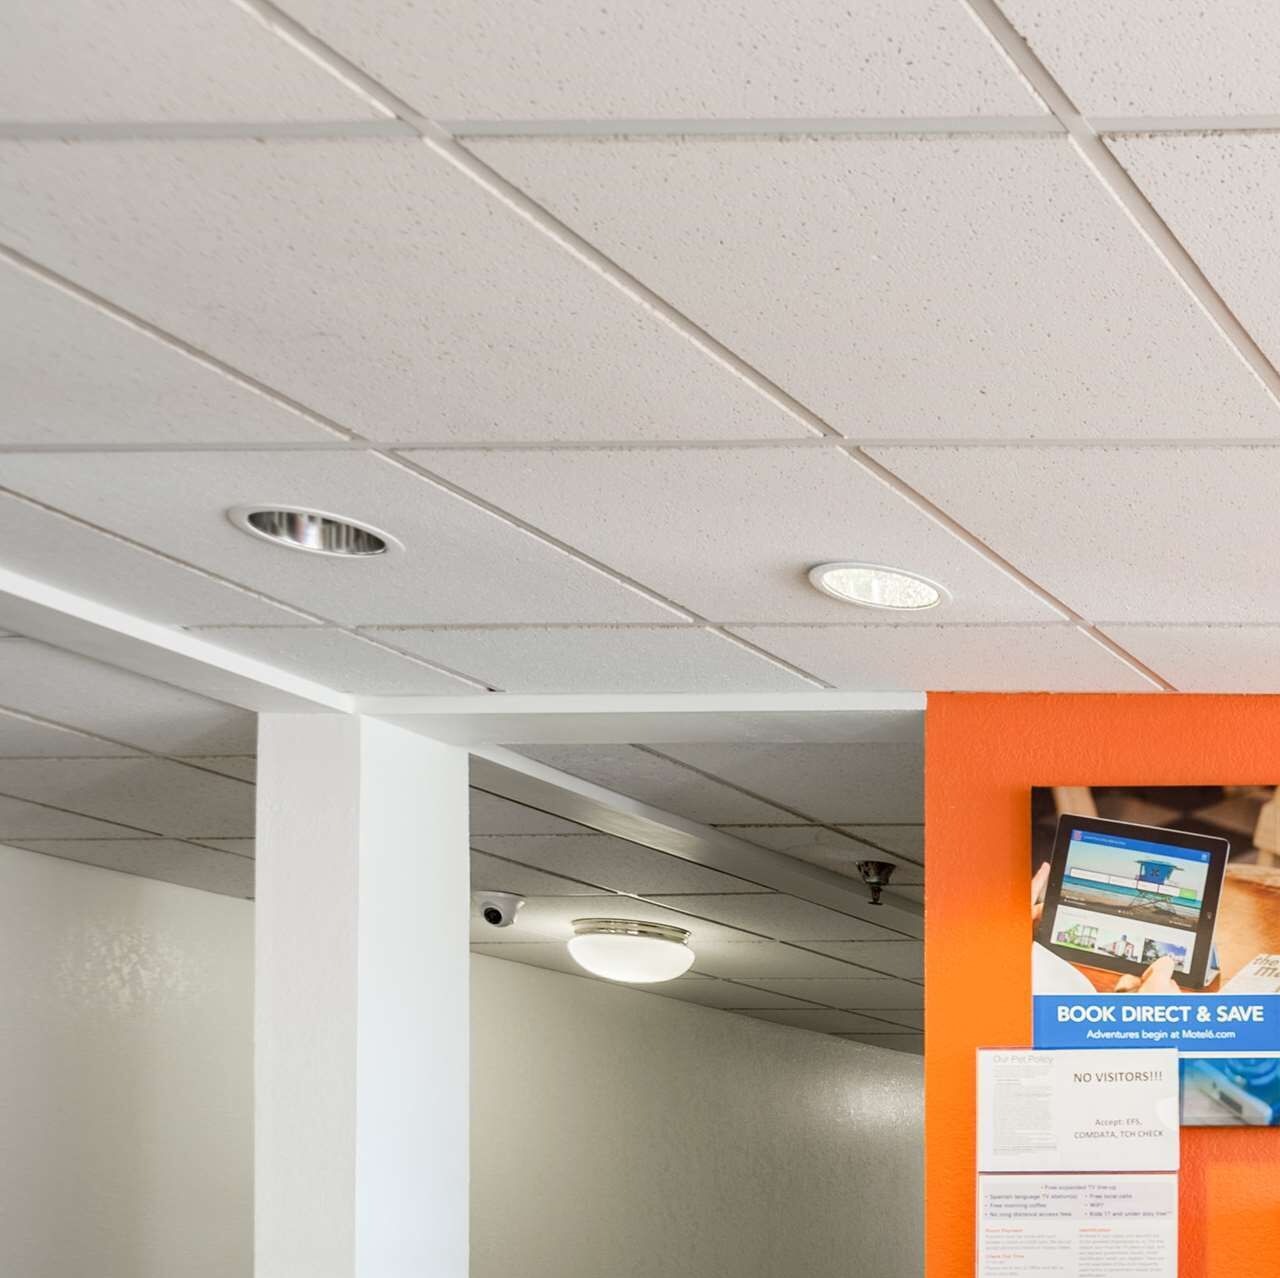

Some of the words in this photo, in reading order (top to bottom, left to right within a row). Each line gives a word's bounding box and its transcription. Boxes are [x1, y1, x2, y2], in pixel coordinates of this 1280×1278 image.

[1057, 1006, 1116, 1022] BOOK
[1122, 1006, 1191, 1022] DIRECT
[1197, 1006, 1211, 1022] &
[1216, 1005, 1264, 1022] SAVE
[1087, 1029, 1139, 1039] Adventures
[1142, 1029, 1168, 1041] begin
[1170, 1030, 1180, 1039] at
[1182, 1029, 1236, 1039] Motel6.com
[1074, 1072, 1092, 1083] NO
[1096, 1071, 1163, 1083] VISITORS!!!
